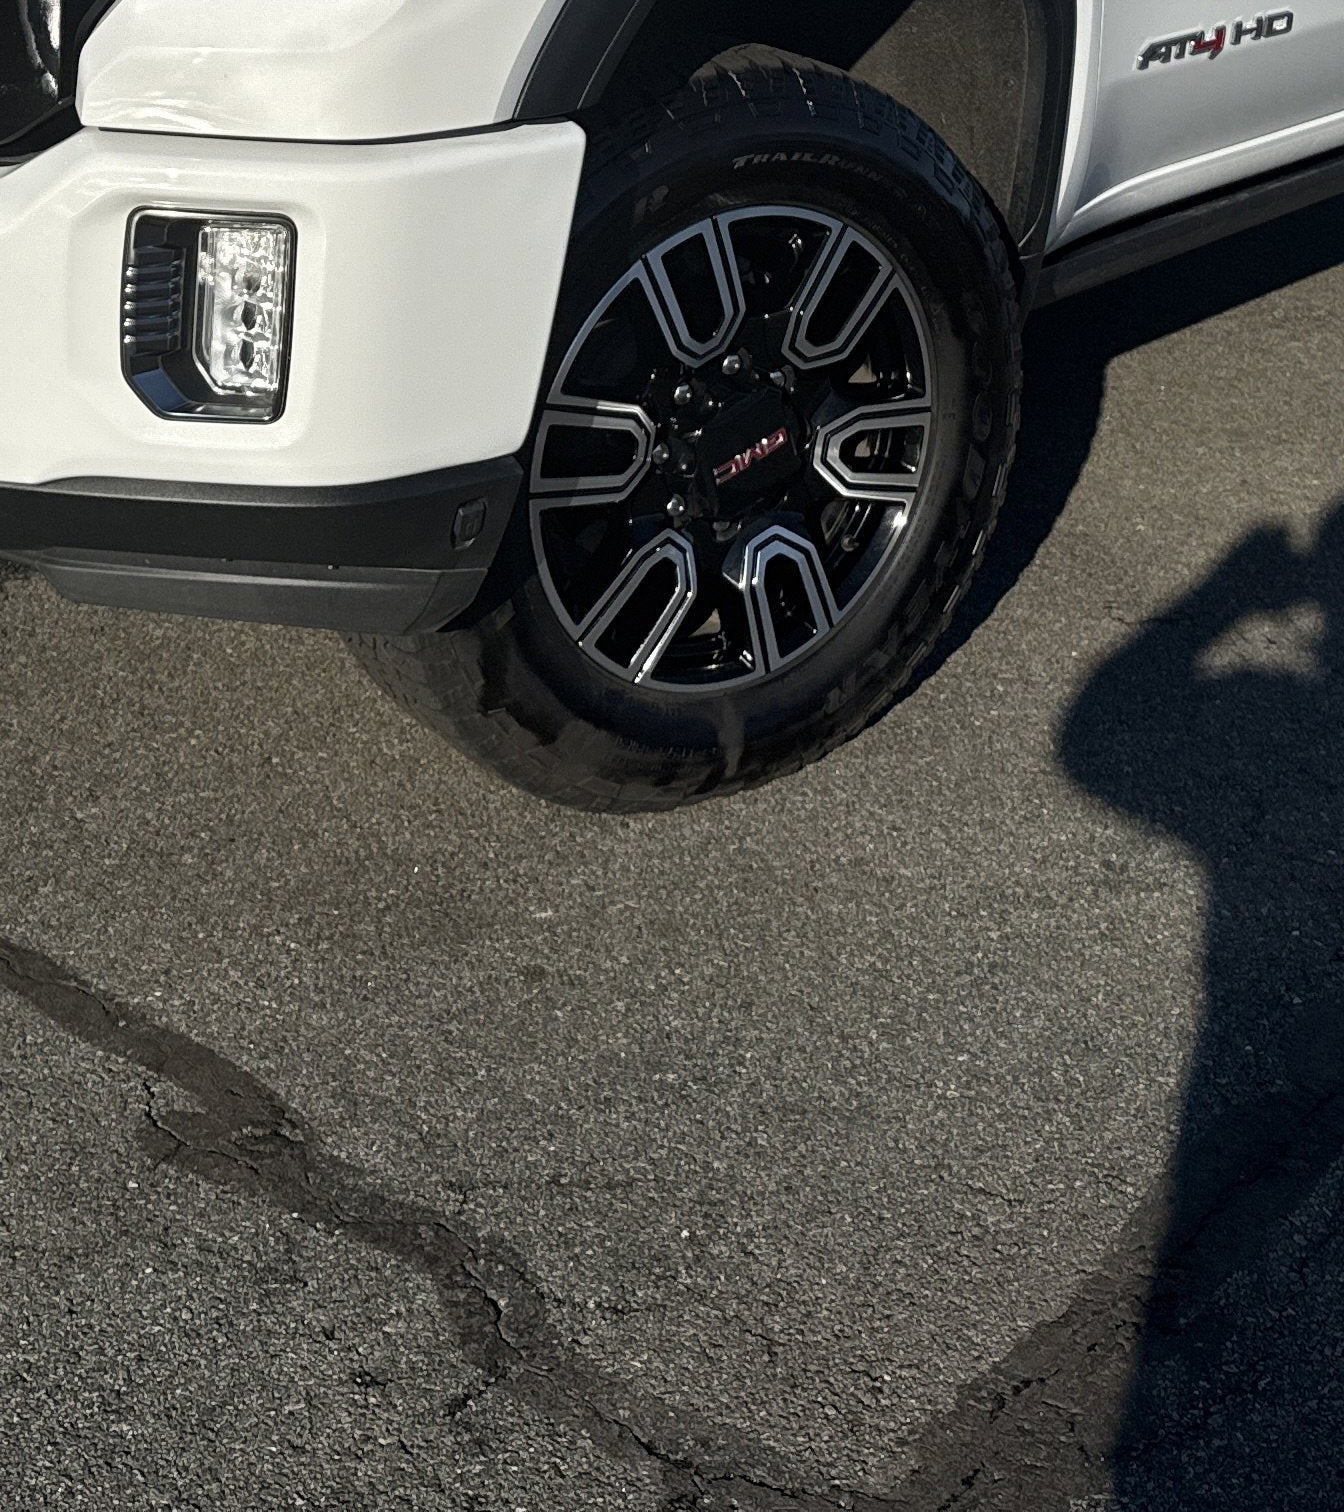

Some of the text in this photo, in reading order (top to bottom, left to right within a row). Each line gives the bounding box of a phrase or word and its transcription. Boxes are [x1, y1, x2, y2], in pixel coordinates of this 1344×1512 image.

[1134, 8, 1295, 71] AT4 HD
[712, 427, 789, 486] GMC
